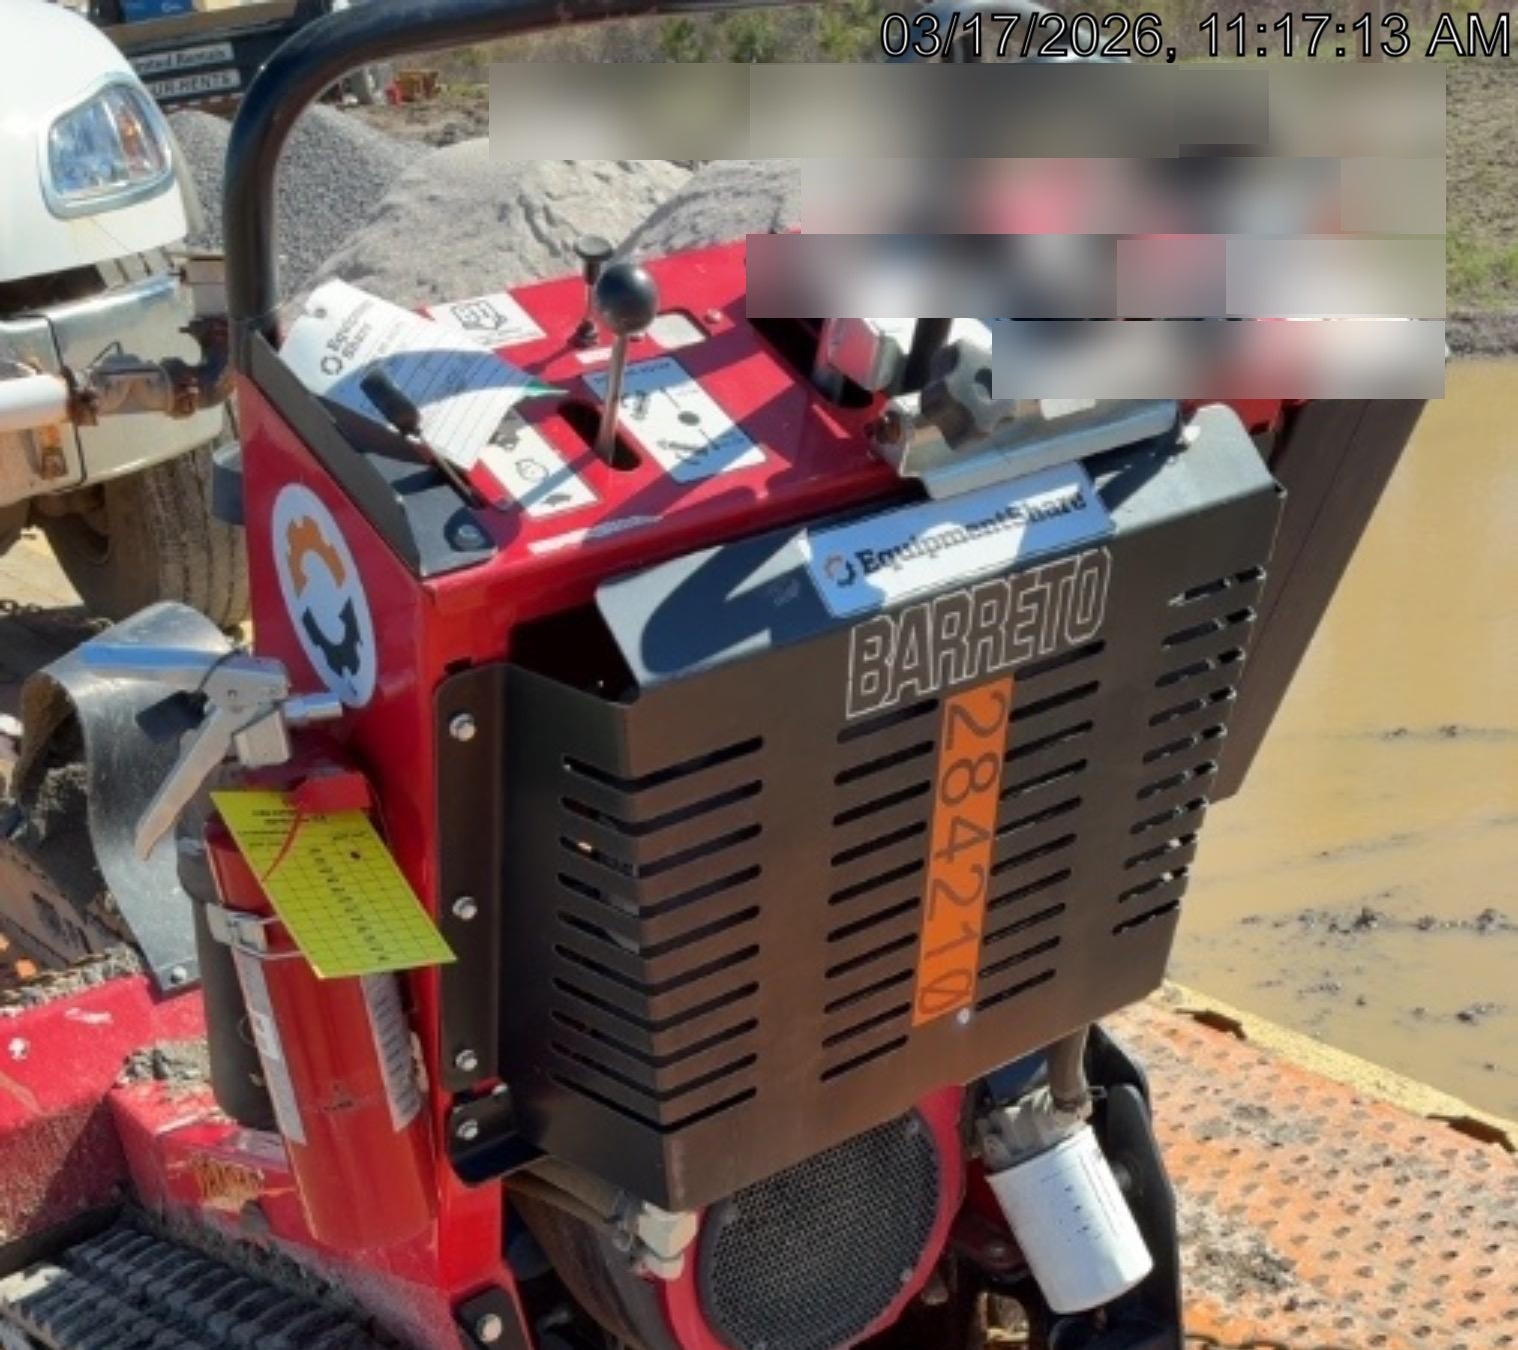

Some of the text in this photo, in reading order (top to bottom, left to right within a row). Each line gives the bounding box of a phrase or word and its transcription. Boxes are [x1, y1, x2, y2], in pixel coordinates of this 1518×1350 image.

[855, 491, 1087, 575] EquipmentShare
[846, 545, 1112, 720] BARRETO
[918, 690, 1007, 1016] 284210
